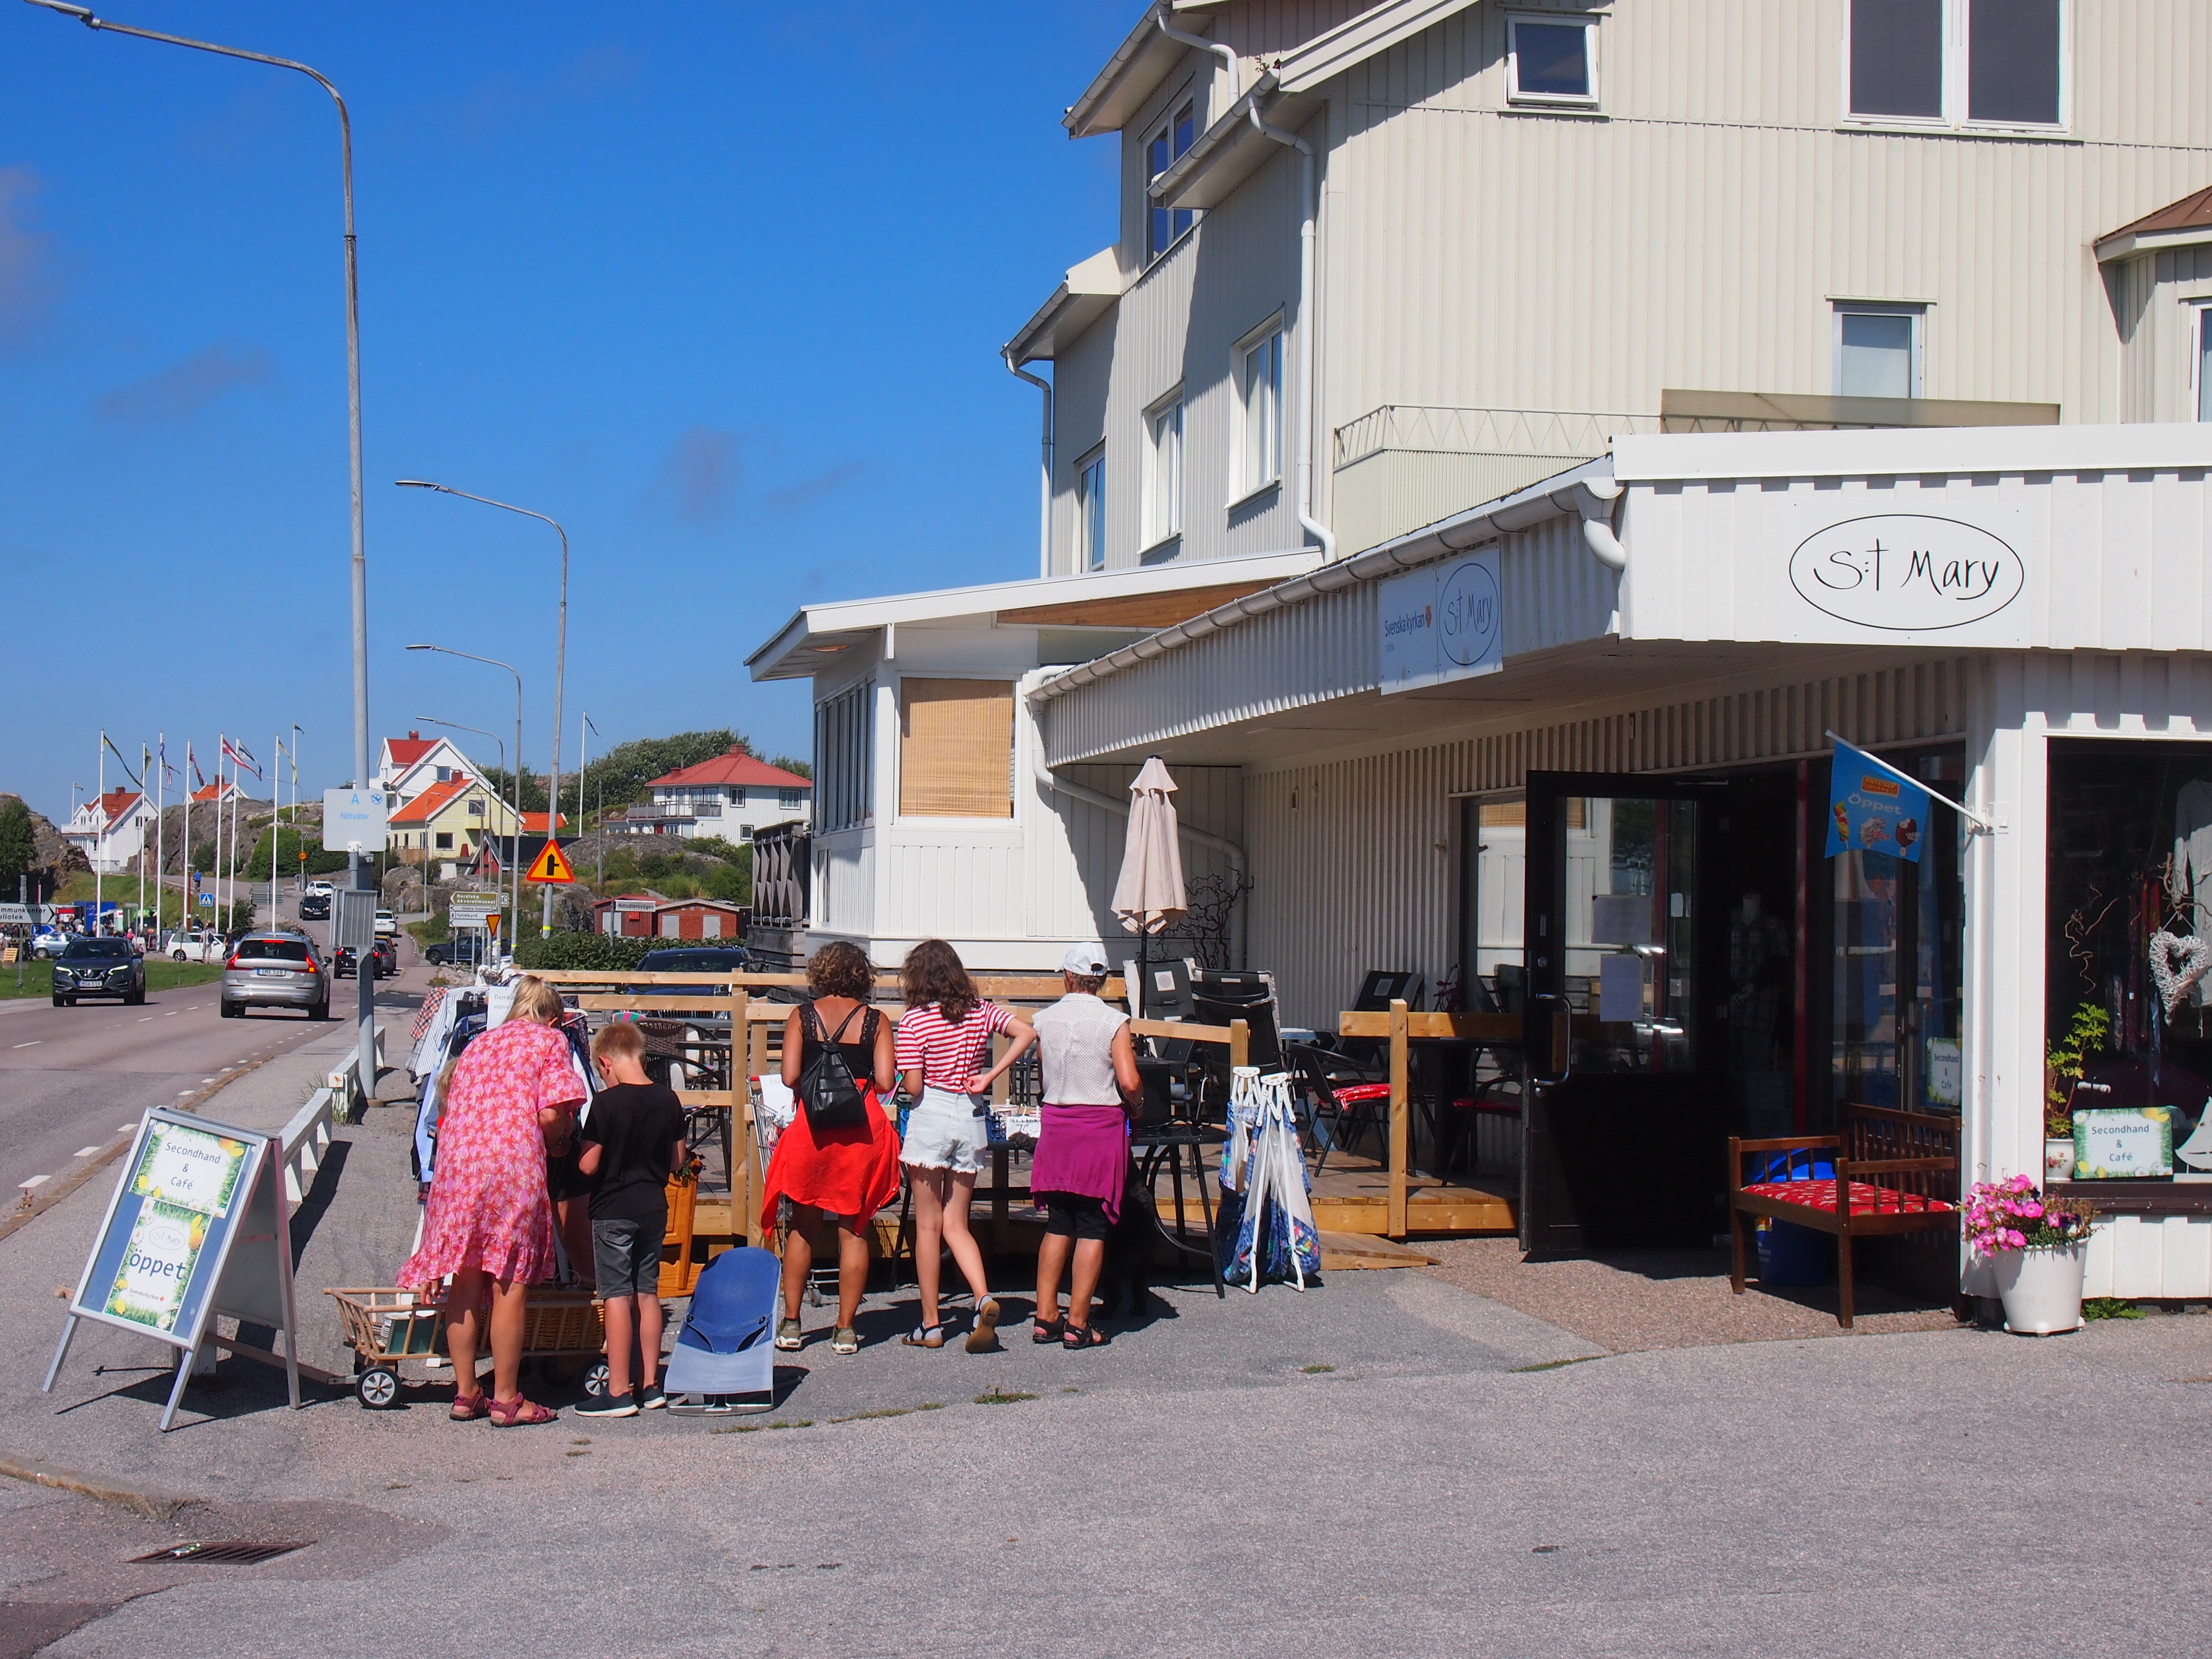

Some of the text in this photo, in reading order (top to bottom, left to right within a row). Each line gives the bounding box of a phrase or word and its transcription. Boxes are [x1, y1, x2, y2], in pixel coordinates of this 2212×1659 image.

[1814, 538, 1999, 600] S:t Mary
[1444, 588, 1492, 635] S:t Mary
[1385, 611, 1425, 637] Svenska kyrkan
[351, 793, 360, 805] A
[1848, 793, 1902, 815] Öppet
[1933, 1053, 1959, 1063] Secondhand
[1941, 1080, 1952, 1090] Café
[2091, 1124, 2149, 1135] Secondhand
[2116, 1139, 2123, 1148] &
[165, 1142, 221, 1164] Secondhand
[2109, 1153, 2132, 1161] Café
[183, 1163, 189, 1172] &
[171, 1177, 193, 1190] Café
[166, 1234, 182, 1246] Mary
[129, 1248, 186, 1280] öppet
[129, 1288, 145, 1296] Svenska
[145, 1291, 159, 1300] kyrkan
